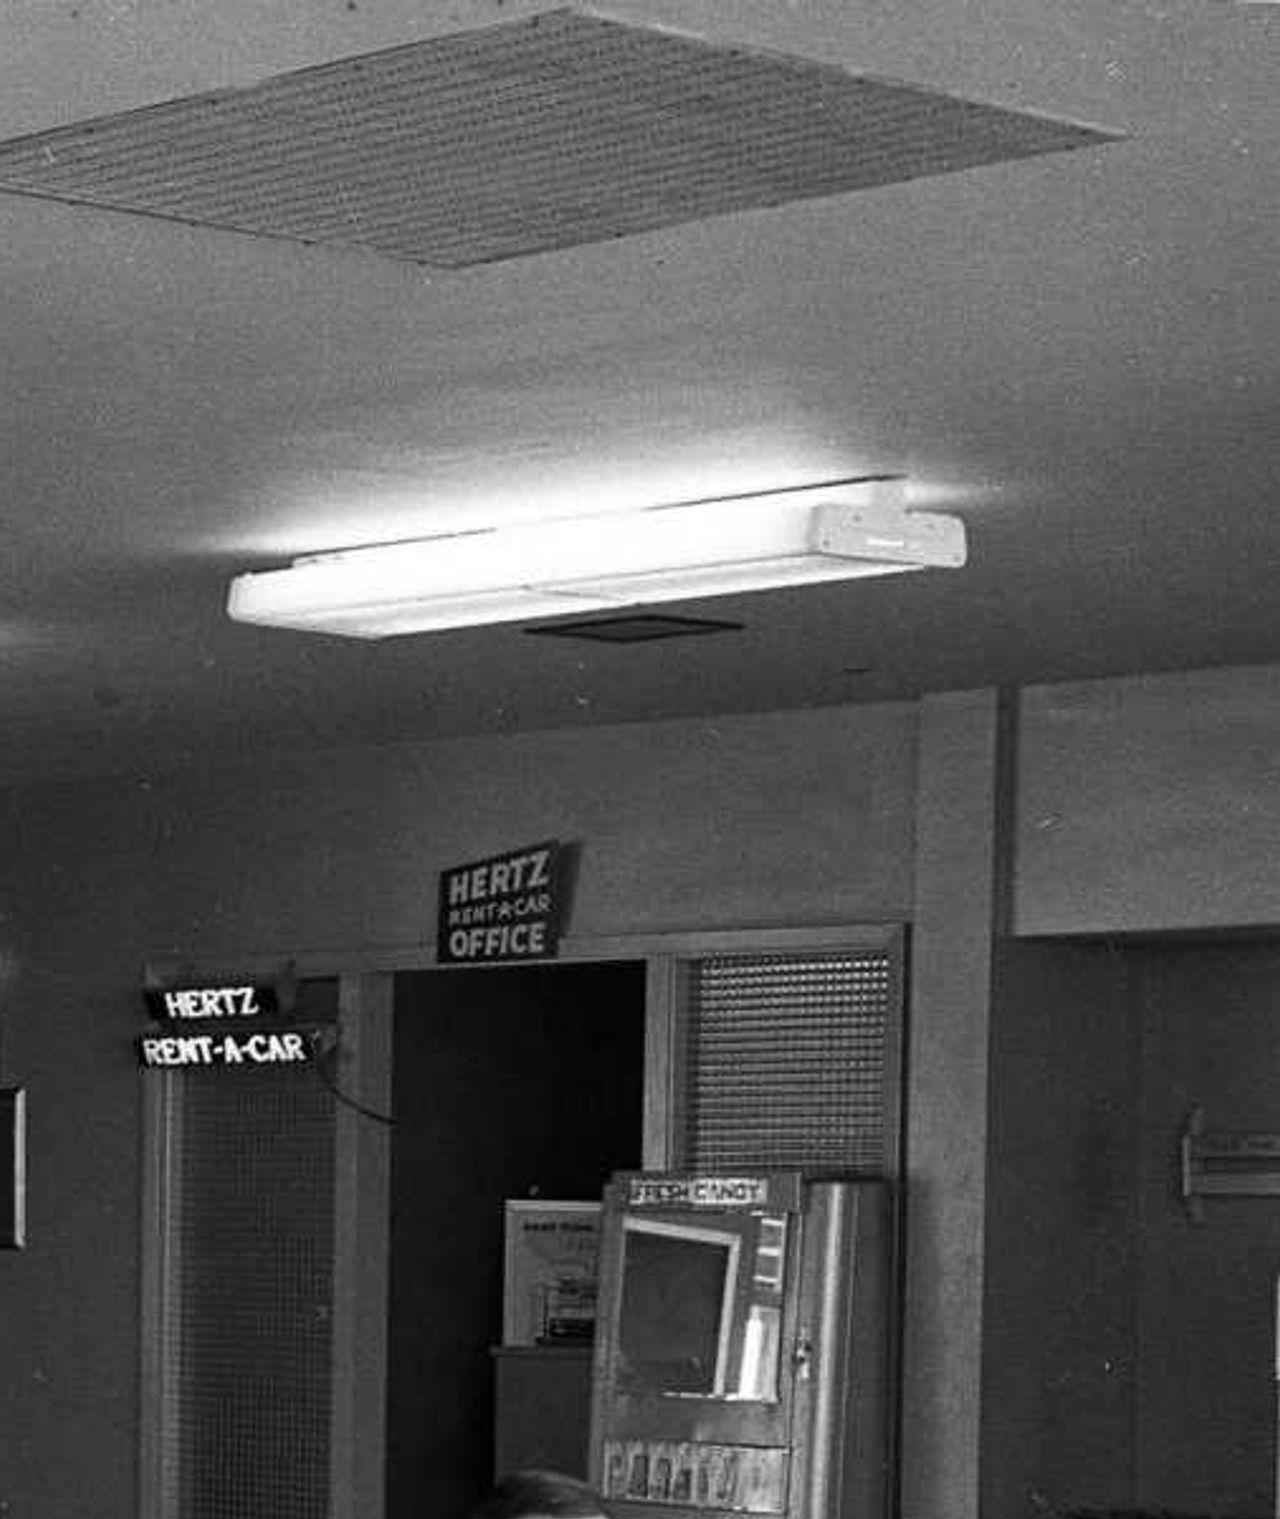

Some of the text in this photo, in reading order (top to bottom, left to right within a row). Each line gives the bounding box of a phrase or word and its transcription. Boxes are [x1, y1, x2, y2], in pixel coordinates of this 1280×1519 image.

[448, 850, 550, 905] HERTZ
[449, 922, 547, 957] OFFICE
[164, 986, 260, 1017] HERTZ
[143, 1033, 307, 1066] RENT-A-CAR
